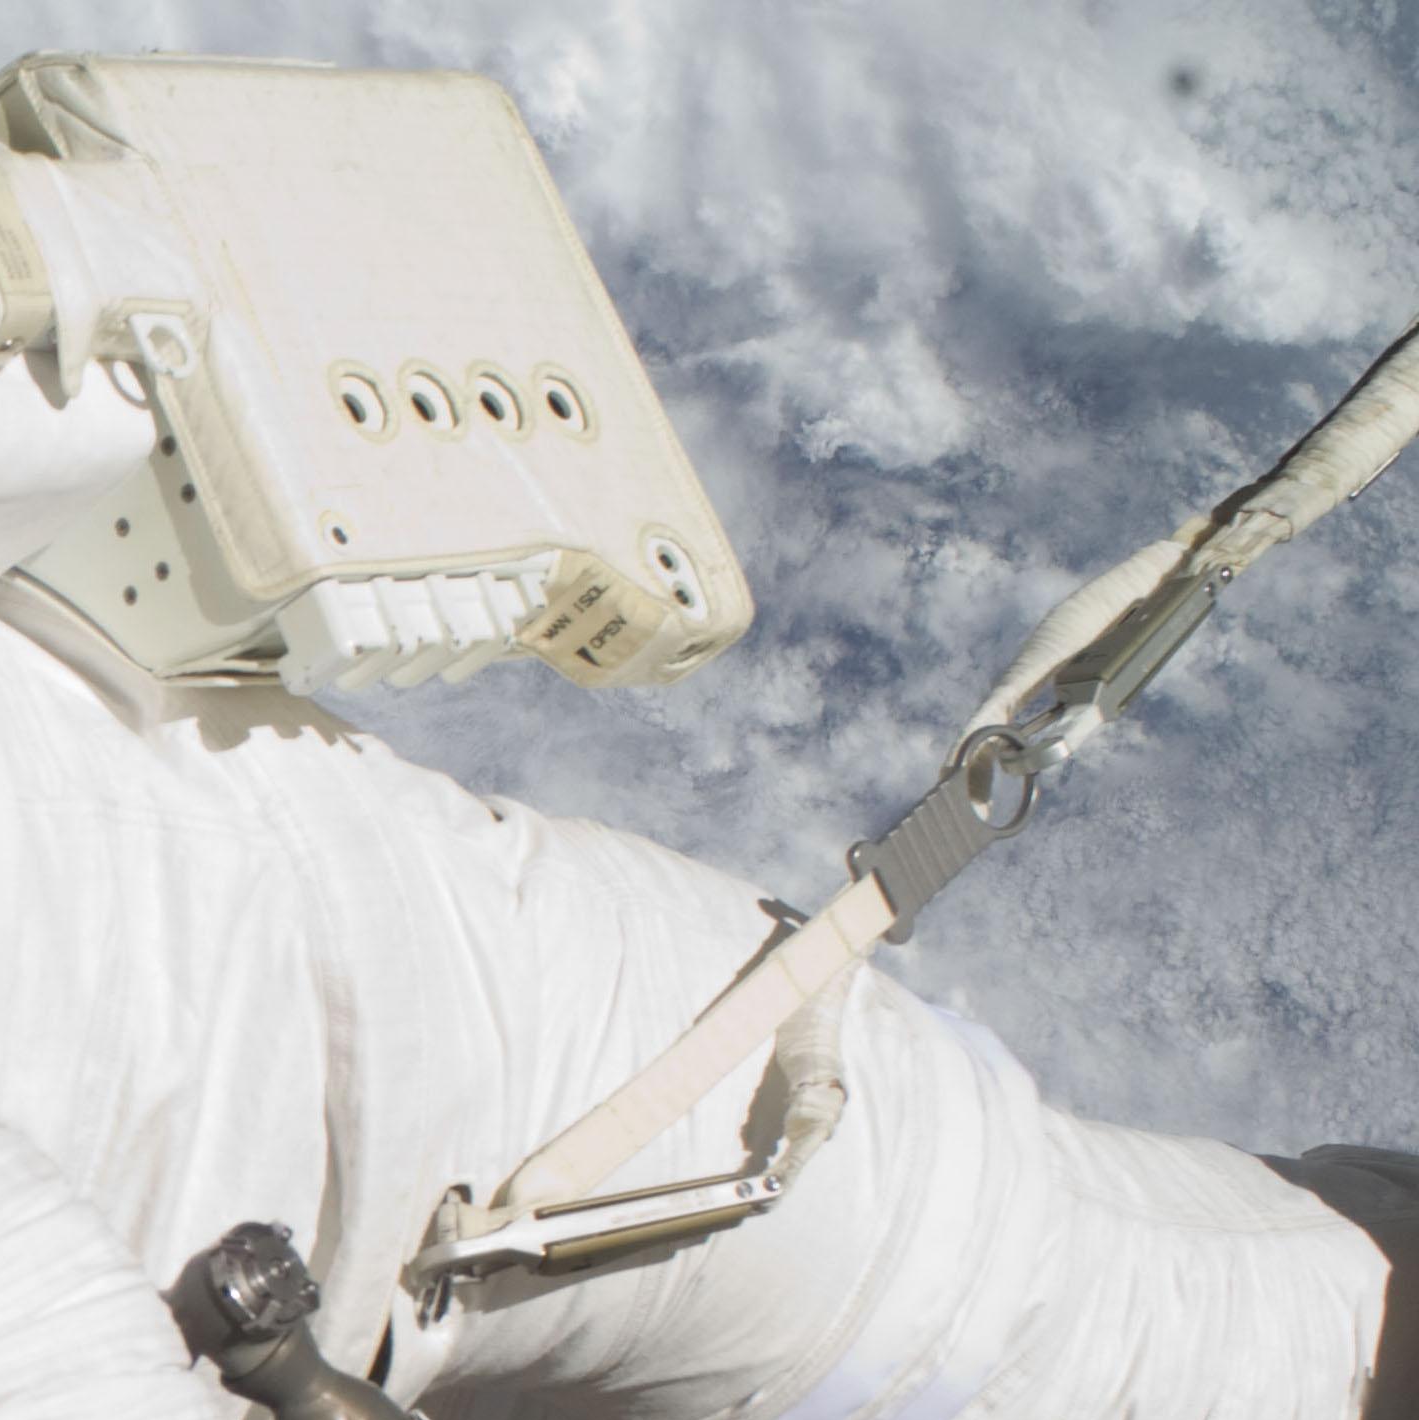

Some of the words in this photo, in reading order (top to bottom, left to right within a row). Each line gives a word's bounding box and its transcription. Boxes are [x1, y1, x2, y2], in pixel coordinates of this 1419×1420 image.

[542, 613, 571, 640] MAN
[573, 585, 609, 613] ISOL
[589, 614, 627, 649] OPEN
